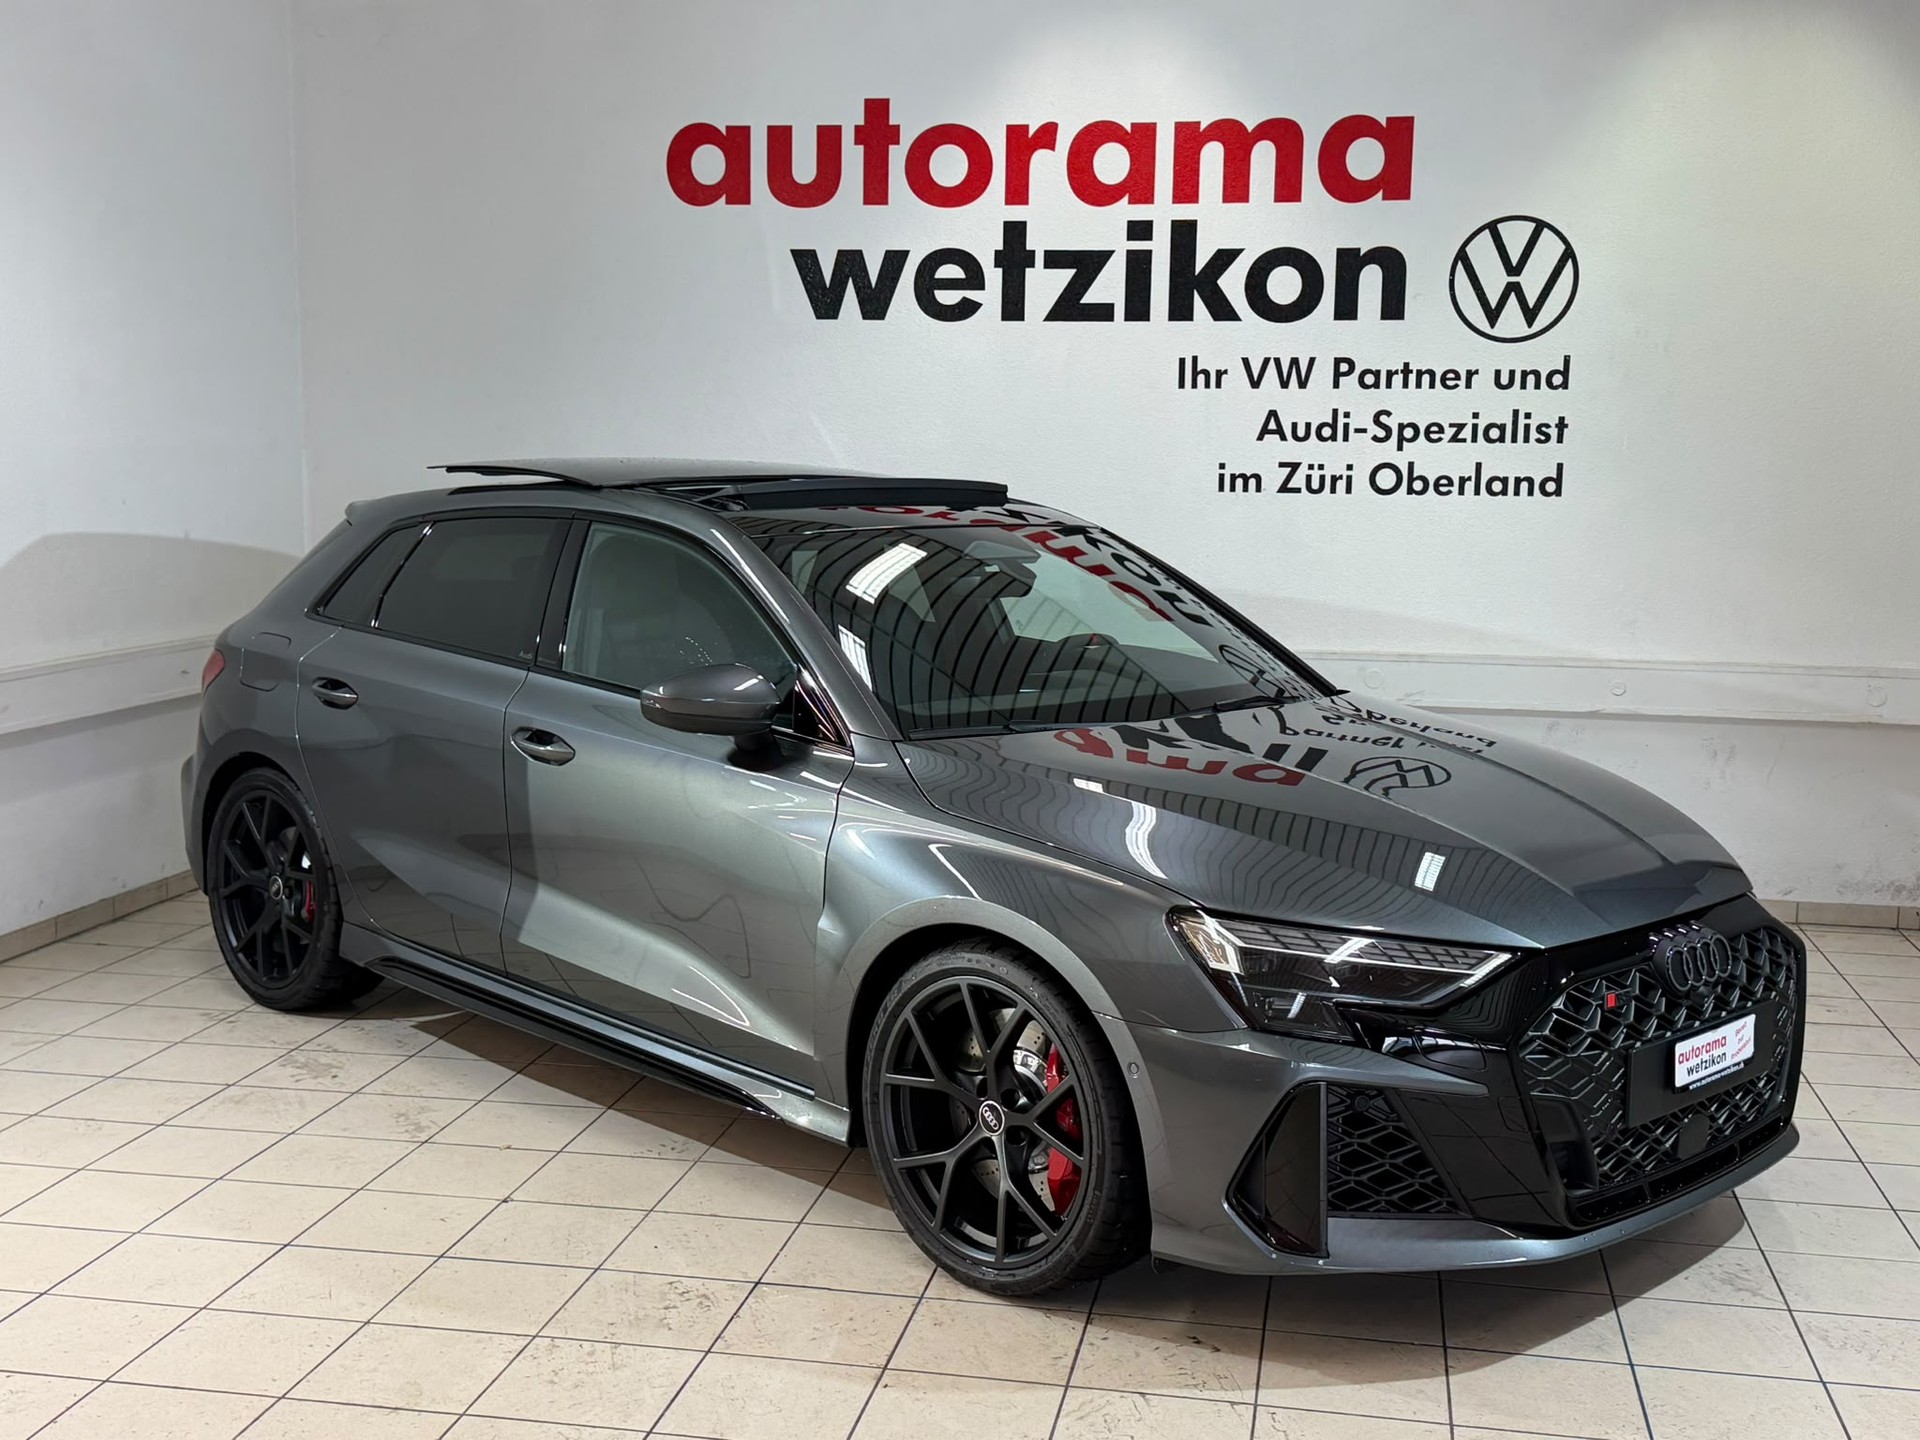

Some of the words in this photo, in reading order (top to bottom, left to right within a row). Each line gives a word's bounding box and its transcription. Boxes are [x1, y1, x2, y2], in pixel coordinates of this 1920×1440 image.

[666, 98, 1415, 208] autorama
[789, 220, 1407, 323] wetzikon
[1178, 355, 1228, 390] Ihr
[1240, 356, 1317, 390] VW
[1332, 356, 1480, 391] Partner
[1493, 354, 1571, 391] und
[1255, 408, 1569, 452] Audi-Spezialist
[1218, 462, 1262, 493] im
[1276, 461, 1354, 495] Züri
[1368, 461, 1564, 498] Oberland
[1678, 1035, 1727, 1065] autorama
[1686, 1052, 1727, 1077] wetzikon
